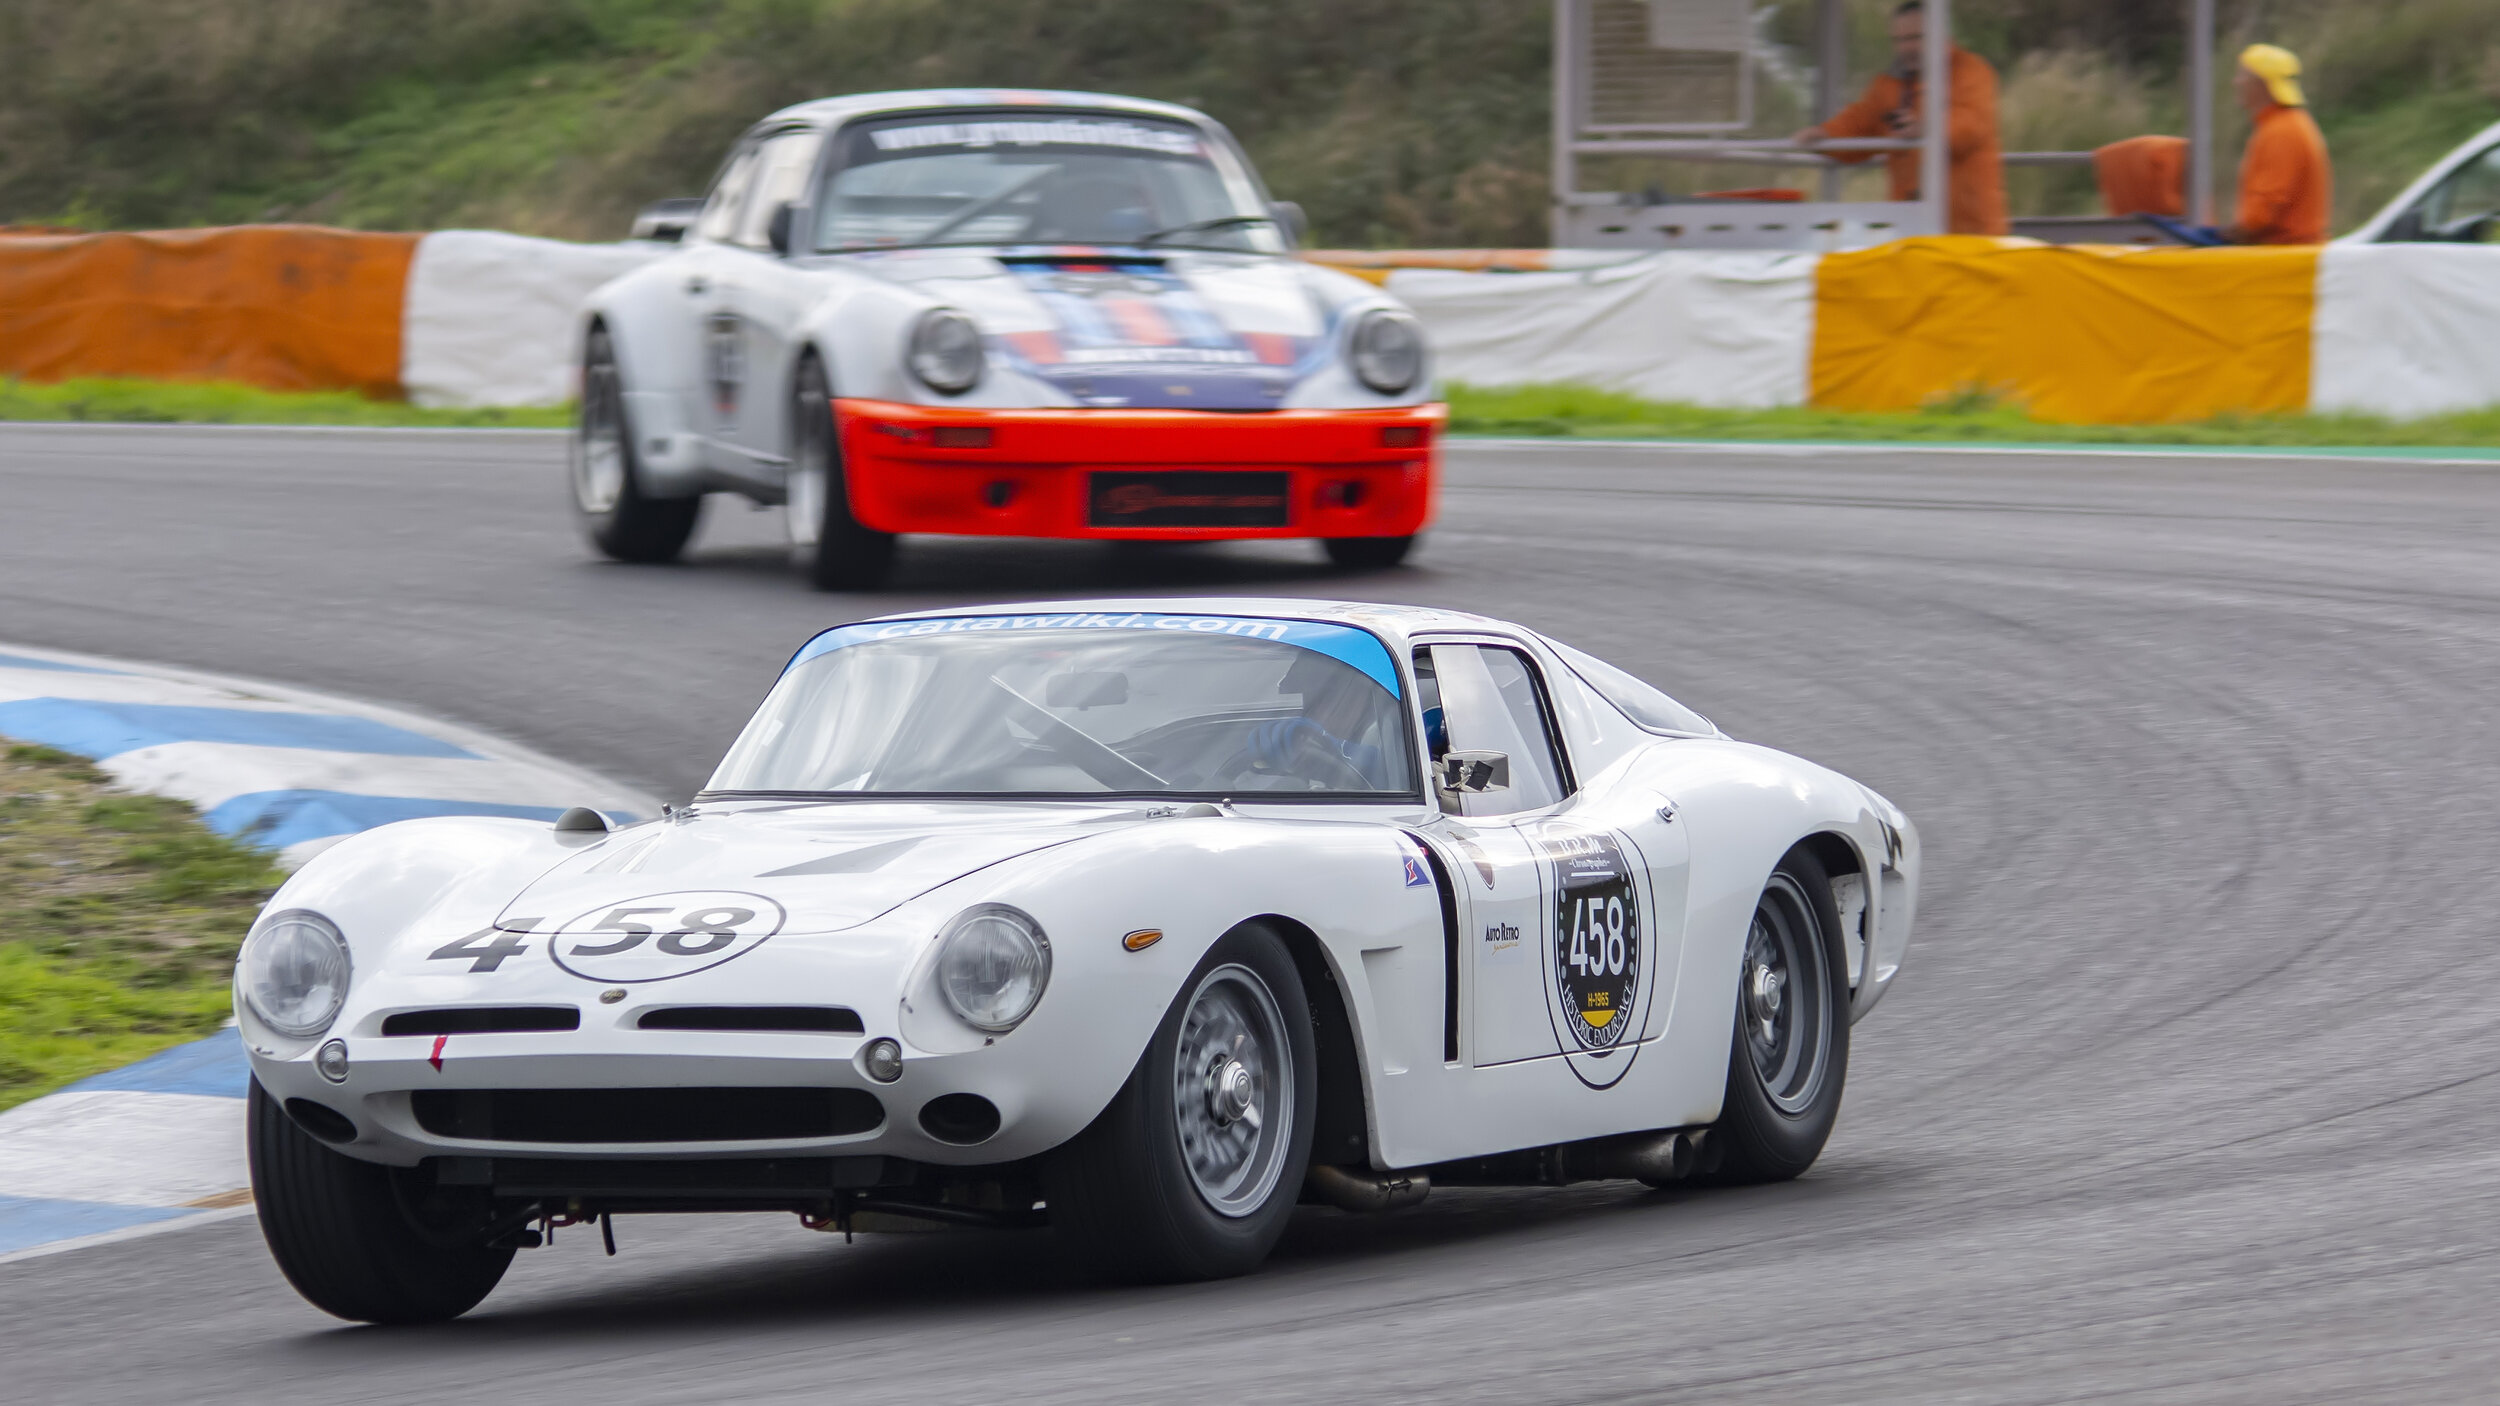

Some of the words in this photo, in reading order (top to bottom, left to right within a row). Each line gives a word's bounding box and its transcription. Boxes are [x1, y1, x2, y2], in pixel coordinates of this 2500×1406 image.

[876, 613, 1289, 641] catawiki.com
[1569, 896, 1626, 976] 458
[1564, 984, 1593, 1043] HISTORIC
[1593, 980, 1633, 1046] ENDURANCE
